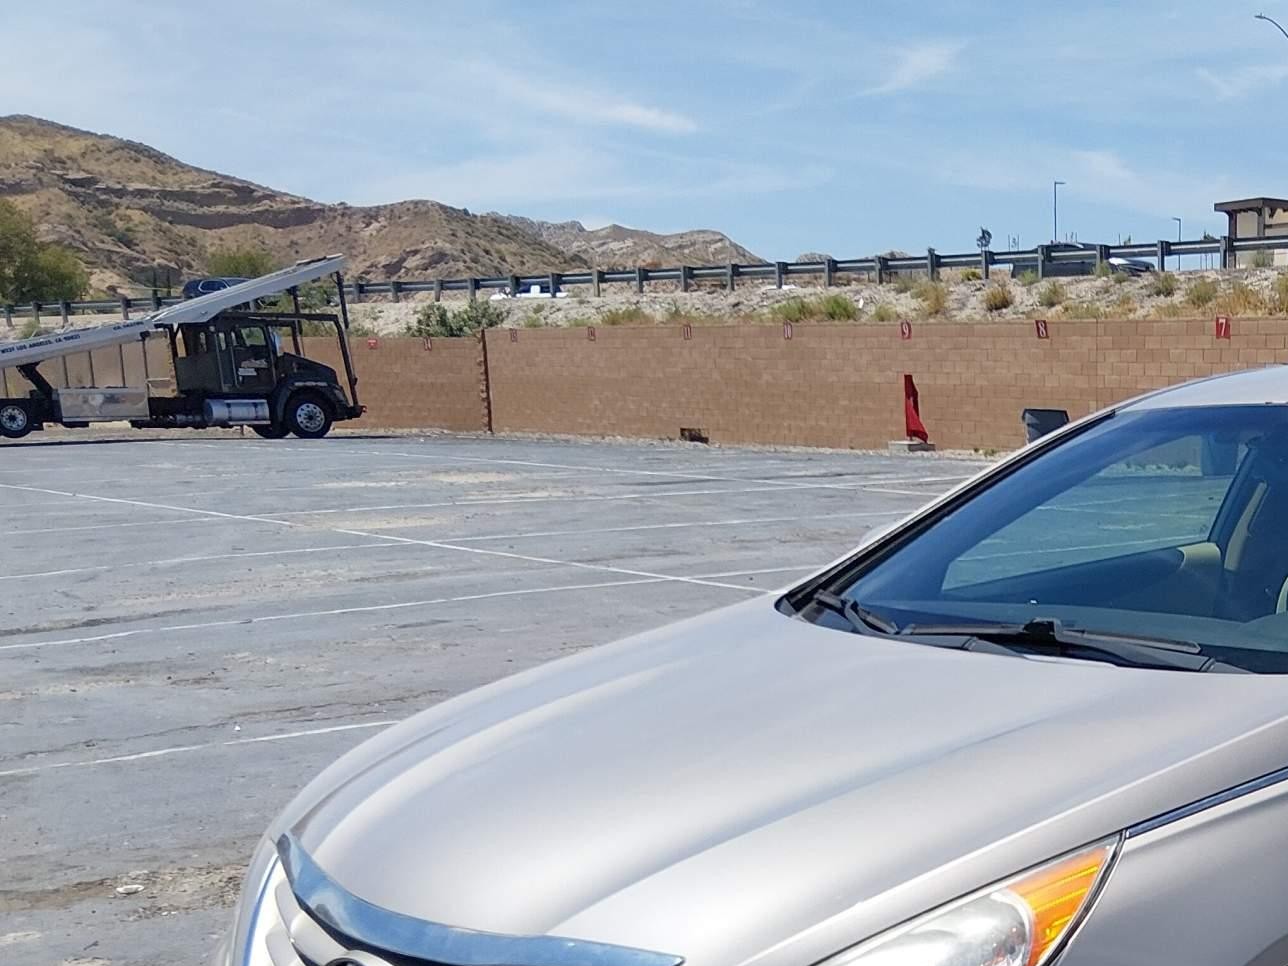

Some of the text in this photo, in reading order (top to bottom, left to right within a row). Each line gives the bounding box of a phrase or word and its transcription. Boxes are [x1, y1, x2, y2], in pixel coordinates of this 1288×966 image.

[902, 322, 909, 338] 9
[1038, 321, 1046, 337] 8
[1218, 318, 1226, 336] 7
